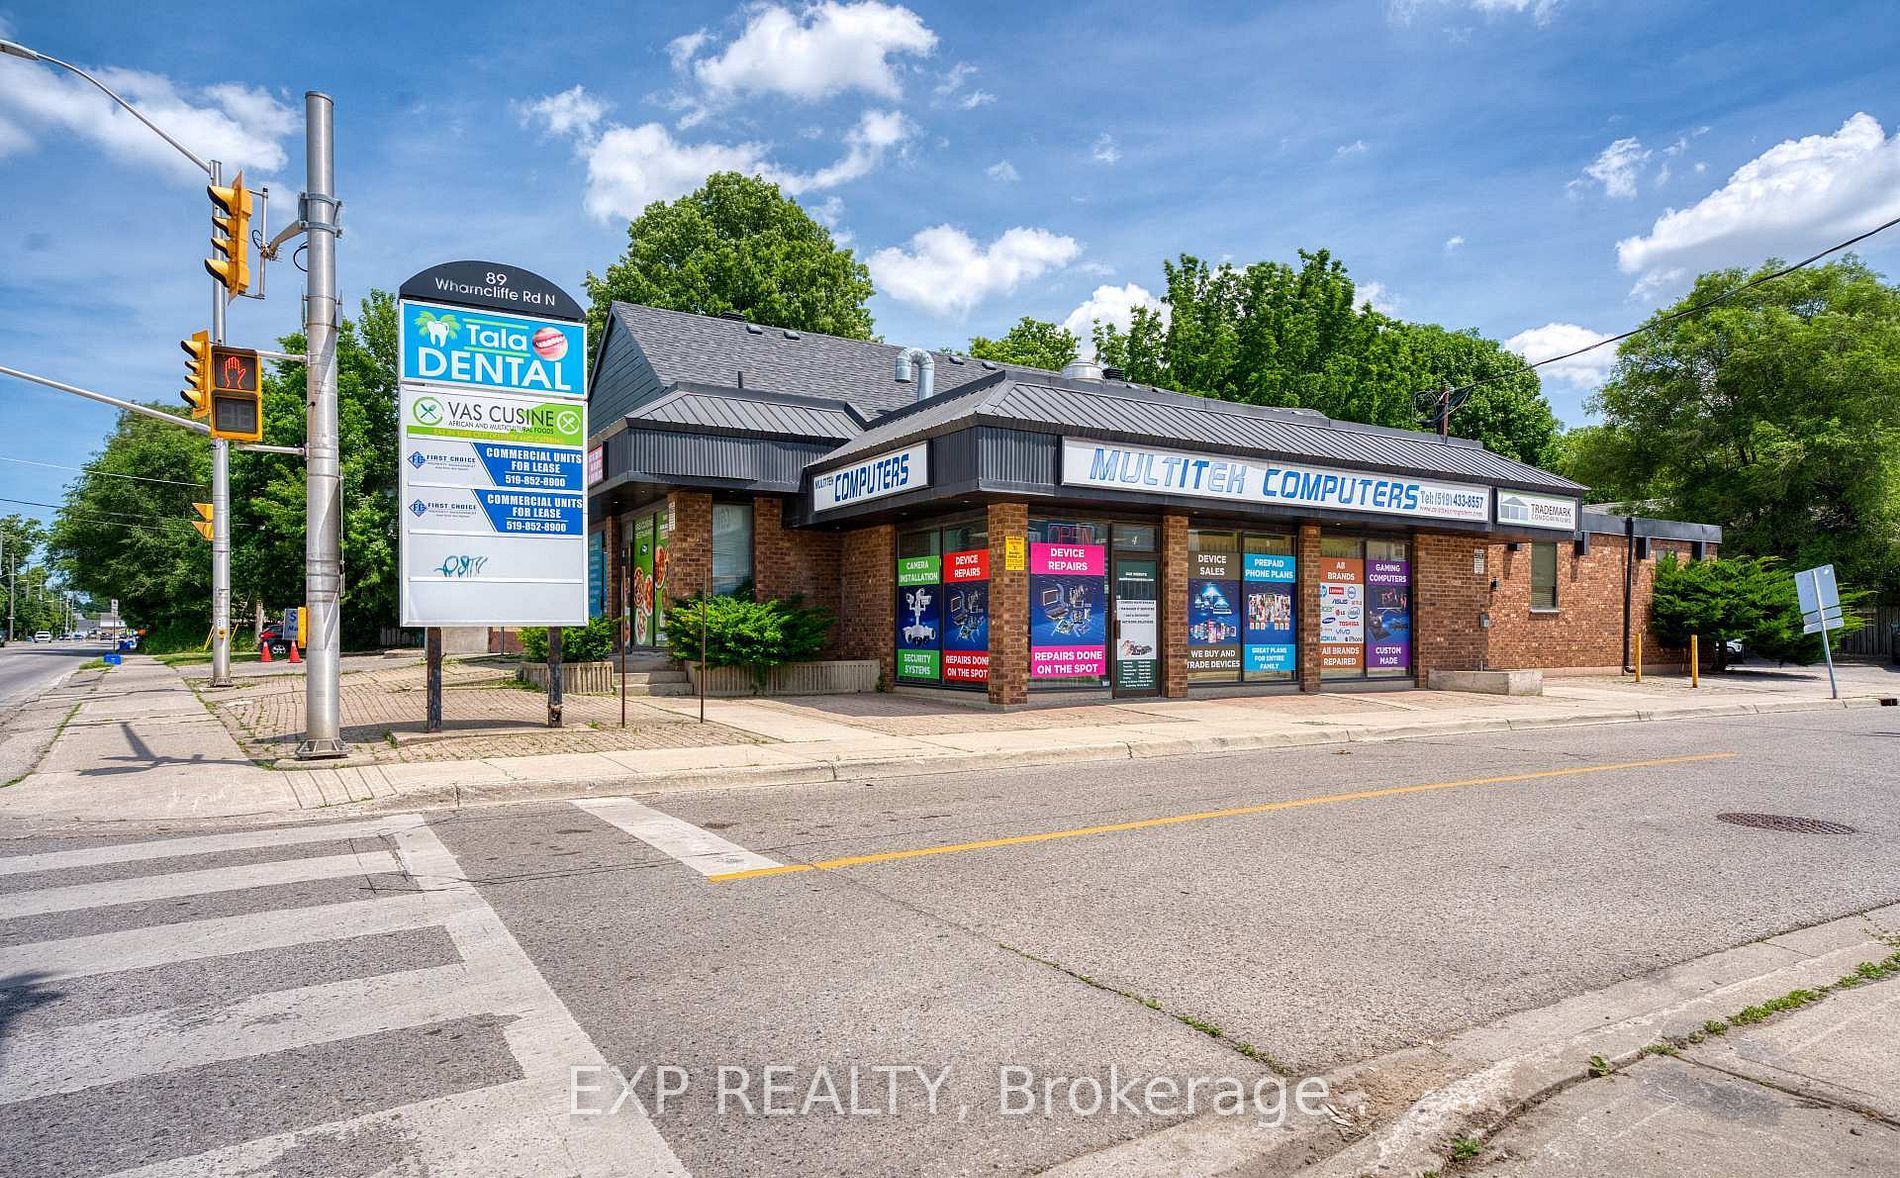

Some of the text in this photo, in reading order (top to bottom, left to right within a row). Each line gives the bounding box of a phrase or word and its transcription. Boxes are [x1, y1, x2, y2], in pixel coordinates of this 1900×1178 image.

[485, 271, 508, 286] 89
[434, 277, 556, 307] Wharncliffe Rd N
[465, 323, 528, 351] Tala
[417, 346, 572, 392] DENTAL
[447, 401, 555, 428] VAS CUSINE
[448, 420, 474, 429] AFRICAN
[475, 422, 489, 430] AND
[534, 427, 555, 436] FOODS
[426, 454, 477, 464] FIRST CHOICE
[486, 447, 583, 464] COMMERCIAL UNITS
[511, 460, 561, 474] FOR LEASE
[505, 474, 566, 488] 519-852-8900
[834, 452, 910, 502] COMPUTERS
[1089, 447, 1421, 511] MULTITEK COMPUTERS
[450, 503, 477, 511] CHOICE
[487, 494, 583, 509] COMMERCIAL UNITS
[512, 507, 562, 519] FOR LEASE
[1531, 503, 1572, 518] TRADEMARK
[506, 521, 567, 533] 519-852-8900
[1050, 548, 1085, 558] DEVICE
[955, 554, 979, 565] DEVICE
[1197, 554, 1227, 564] DEVICE
[1254, 558, 1285, 568] PREPAID
[906, 560, 929, 570] CAMERA
[1047, 560, 1088, 571] REPAIRS
[1375, 563, 1401, 572] GAMING
[954, 567, 981, 578] REPAIRS
[1200, 566, 1225, 576] SALES
[1245, 569, 1294, 579] PHONE PLANS
[1327, 572, 1355, 581] BRANDS
[899, 571, 938, 583] INSTALLATION
[1369, 573, 1407, 583] COMPUTERS
[1034, 650, 1103, 661] REPAIRS DONE
[1191, 649, 1236, 658] WE BUY AND
[1332, 646, 1360, 655] BRANDS
[1375, 646, 1402, 654] CUSTOM
[903, 653, 932, 664] SECURITY
[945, 654, 972, 665] REPAIRS
[1187, 660, 1240, 668] TRADE DEVICES
[1323, 657, 1357, 666] REPAIRED
[1380, 657, 1399, 665] MADE
[904, 665, 931, 675] SYSTEMS
[947, 667, 988, 679] ON THE SPOT
[1037, 663, 1098, 674] ON THE SPOT
